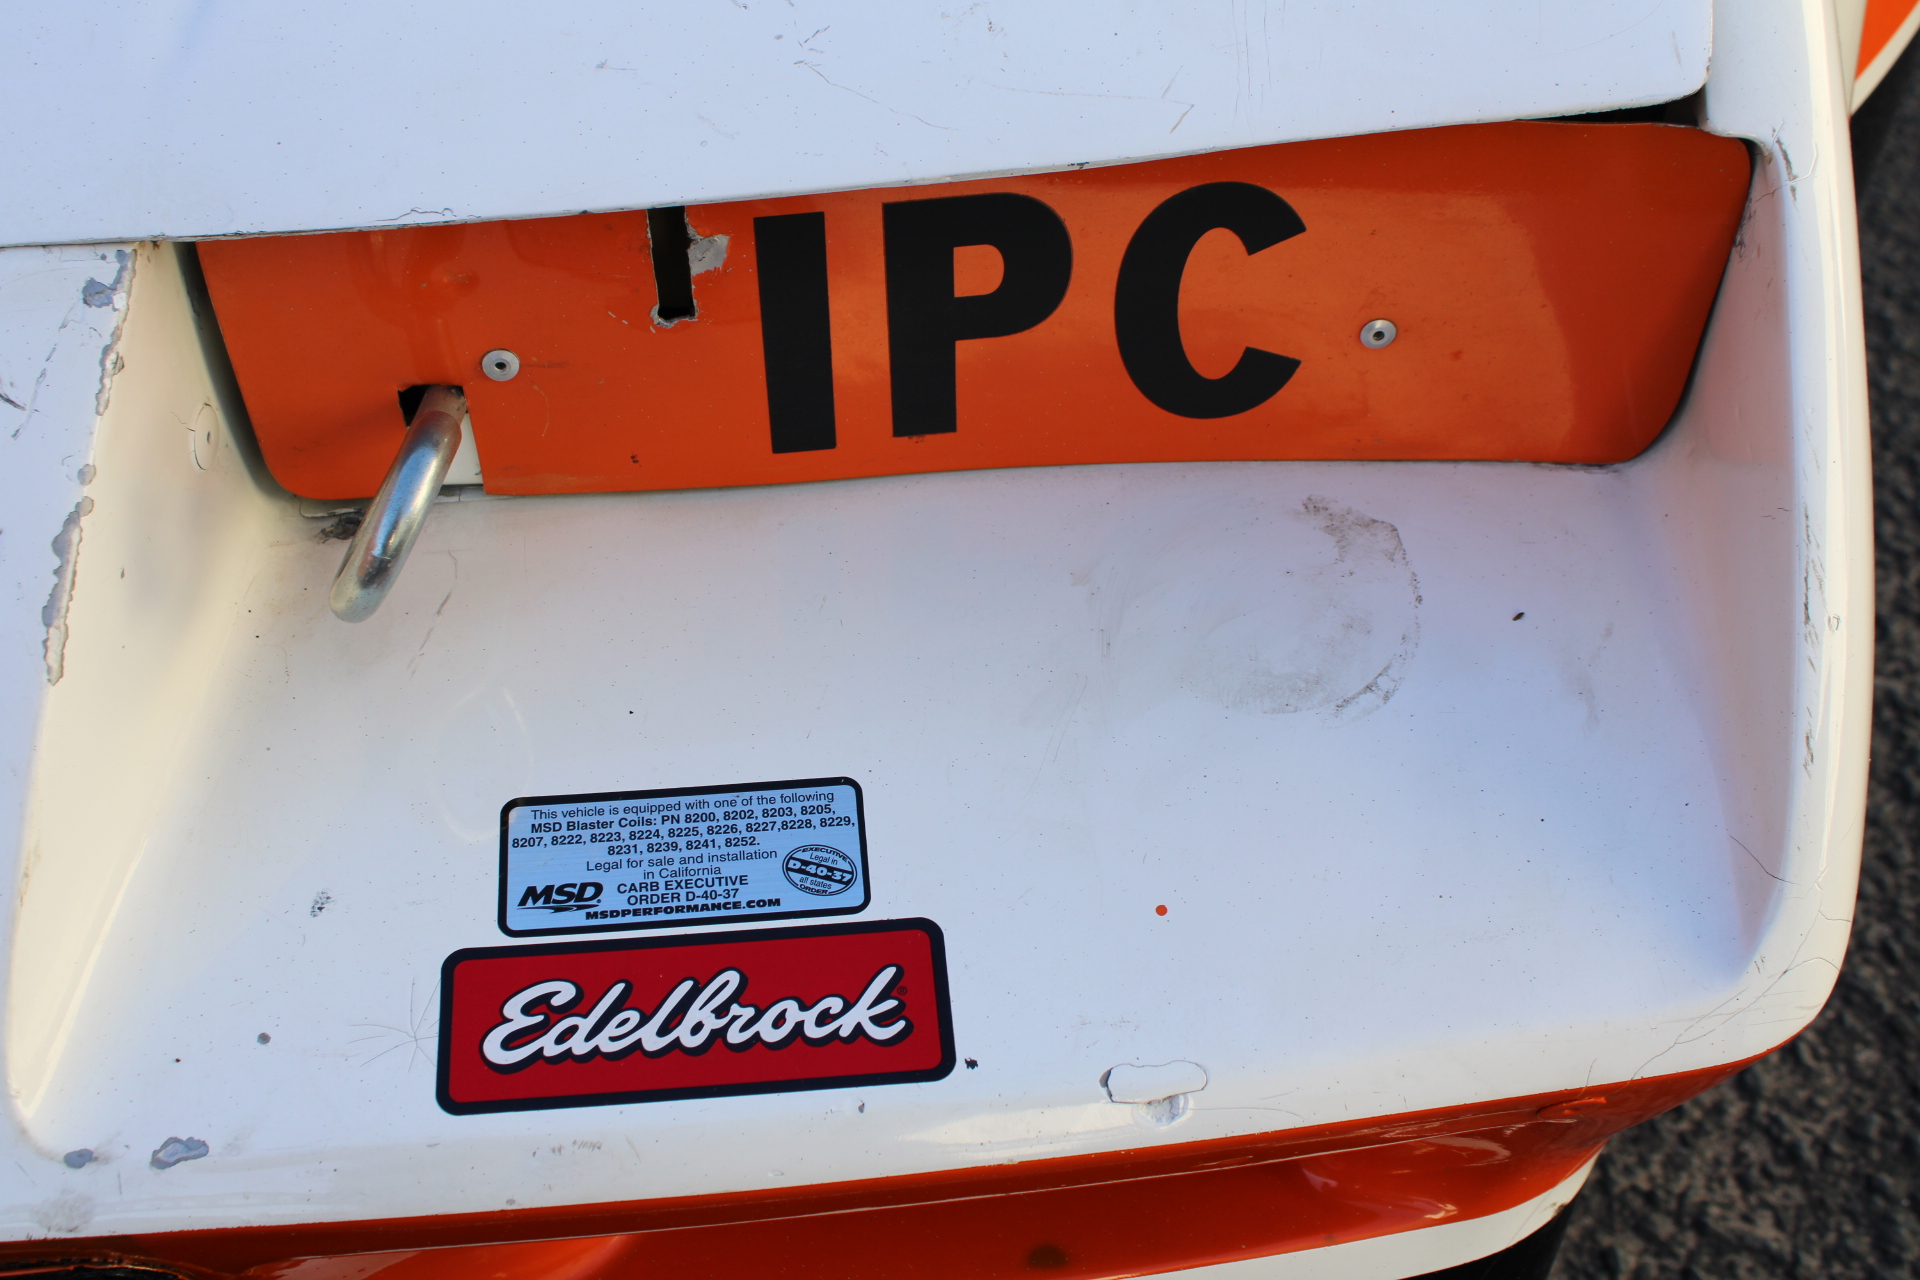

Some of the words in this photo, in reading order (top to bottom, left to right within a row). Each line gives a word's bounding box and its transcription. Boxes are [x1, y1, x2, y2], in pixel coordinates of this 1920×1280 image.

[753, 181, 1306, 454] IPC
[531, 809, 558, 820] This
[561, 806, 605, 819] vehicle
[609, 805, 619, 815] is
[623, 801, 681, 817] equipped
[685, 799, 710, 810] with
[713, 799, 738, 808] one
[741, 795, 753, 806] of
[757, 794, 776, 805] the
[780, 791, 834, 804] following
[531, 822, 562, 833] MSD
[566, 819, 614, 831] Blaster
[618, 816, 657, 828] Coils:
[661, 814, 680, 825] PN
[684, 812, 720, 824] 8200,
[723, 809, 758, 821] 8202,
[762, 806, 797, 818] 8203,
[800, 804, 836, 816] 8205,
[512, 836, 548, 848] 8207,
[551, 834, 586, 846] 8222,
[590, 832, 625, 844] 8223,
[628, 829, 664, 841] 8224,
[668, 826, 703, 838] 8225,
[706, 824, 742, 836] 8226,
[820, 816, 855, 828] 8229,
[608, 844, 643, 856] 8231,
[646, 841, 682, 853] 8239,
[686, 838, 721, 850] 8241,
[724, 836, 760, 848] 8252.
[802, 846, 848, 862] EXECUTIVE
[586, 859, 622, 872] Legal
[627, 858, 644, 868] for
[647, 856, 674, 867] sale
[678, 854, 704, 865] and
[708, 850, 778, 864] installation
[810, 852, 829, 864] Legal
[830, 856, 838, 865] in
[644, 869, 654, 880] in
[659, 865, 722, 878] California
[788, 860, 853, 882] D-40-37
[517, 882, 604, 906] MSD
[617, 881, 660, 894] CARB
[664, 875, 748, 890] EXECUTIVE
[800, 876, 808, 884] all
[810, 878, 832, 890] states
[800, 884, 828, 894] ORDER
[627, 892, 680, 905] ORDER
[686, 888, 740, 902] D-40-37
[586, 898, 780, 920] MSDPERFORMANCE.COM
[481, 966, 908, 1068] Edelbrock
